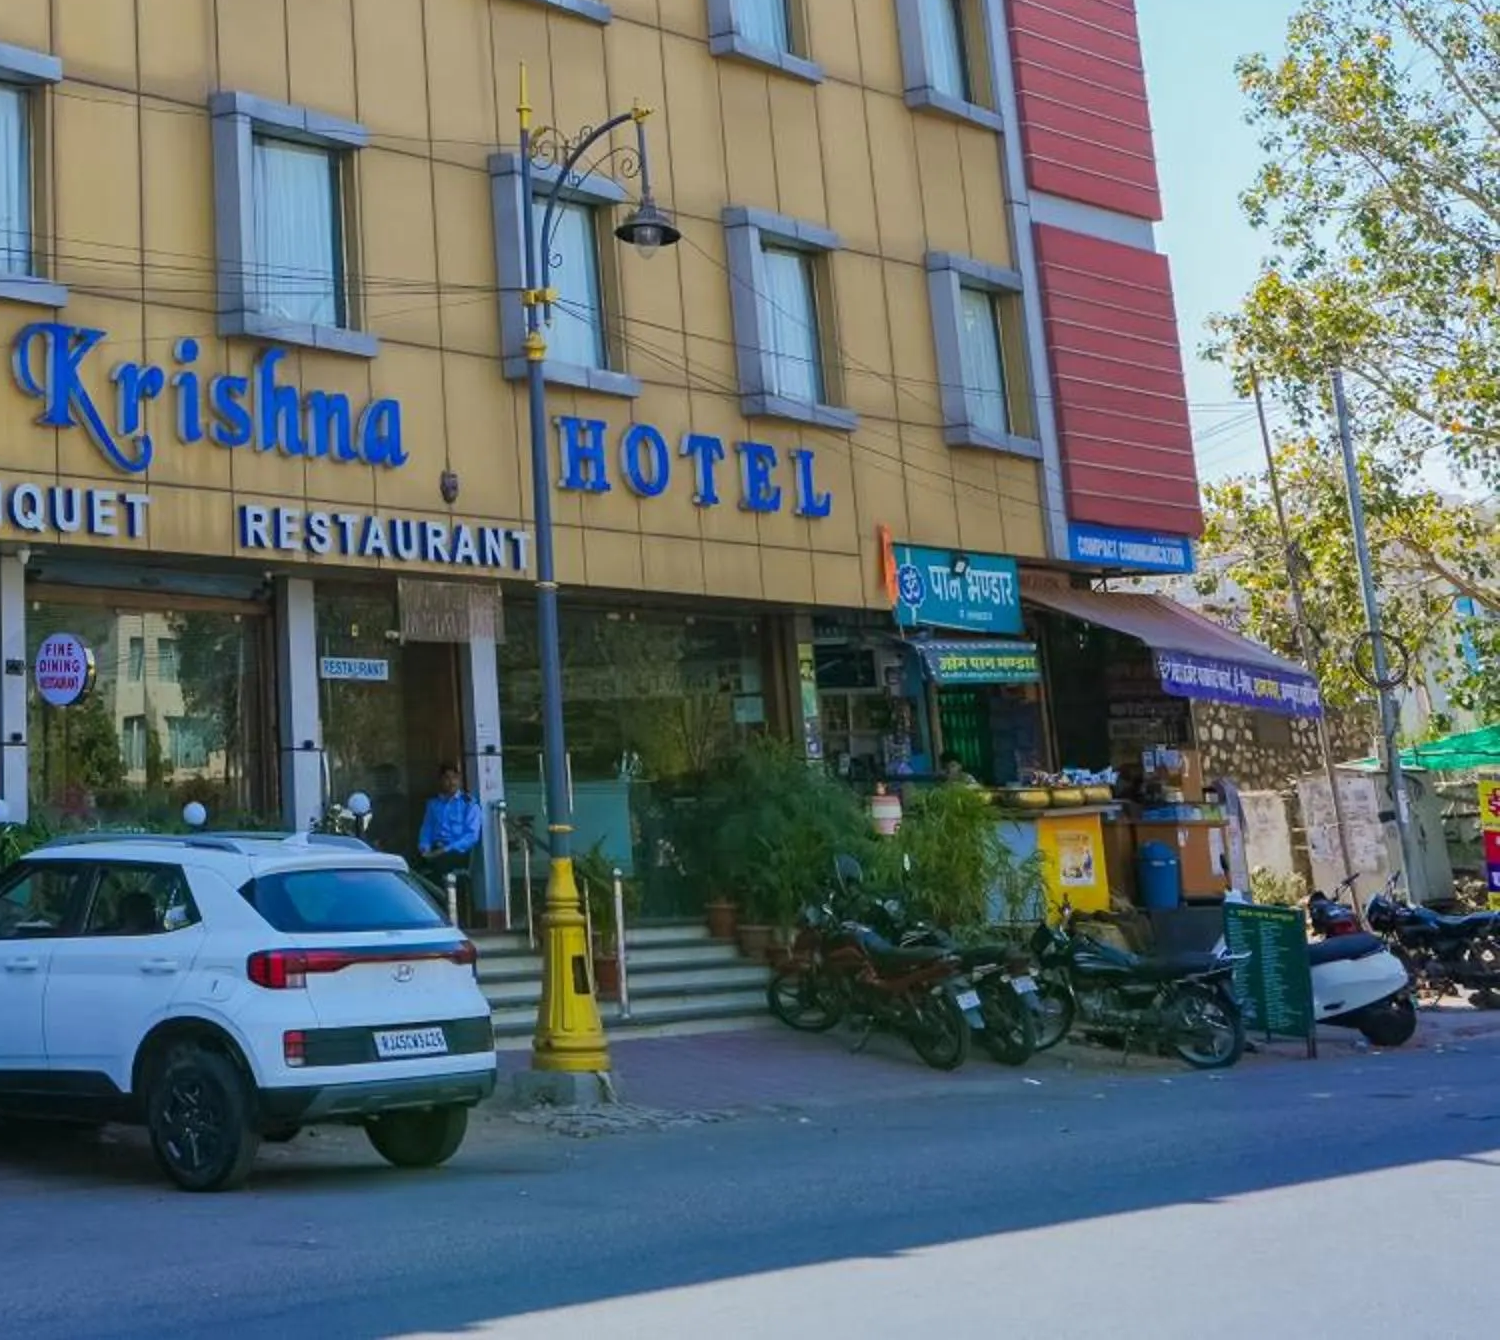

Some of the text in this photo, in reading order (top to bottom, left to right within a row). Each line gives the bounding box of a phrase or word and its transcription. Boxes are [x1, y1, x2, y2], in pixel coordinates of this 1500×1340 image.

[12, 321, 831, 519] Krishna HOTEL
[239, 504, 531, 571] RESTAURANT
[928, 564, 1014, 606] पान भण्डार
[45, 643, 74, 656] FINE
[39, 660, 81, 674] DINING
[323, 659, 385, 677] RESTAURANT
